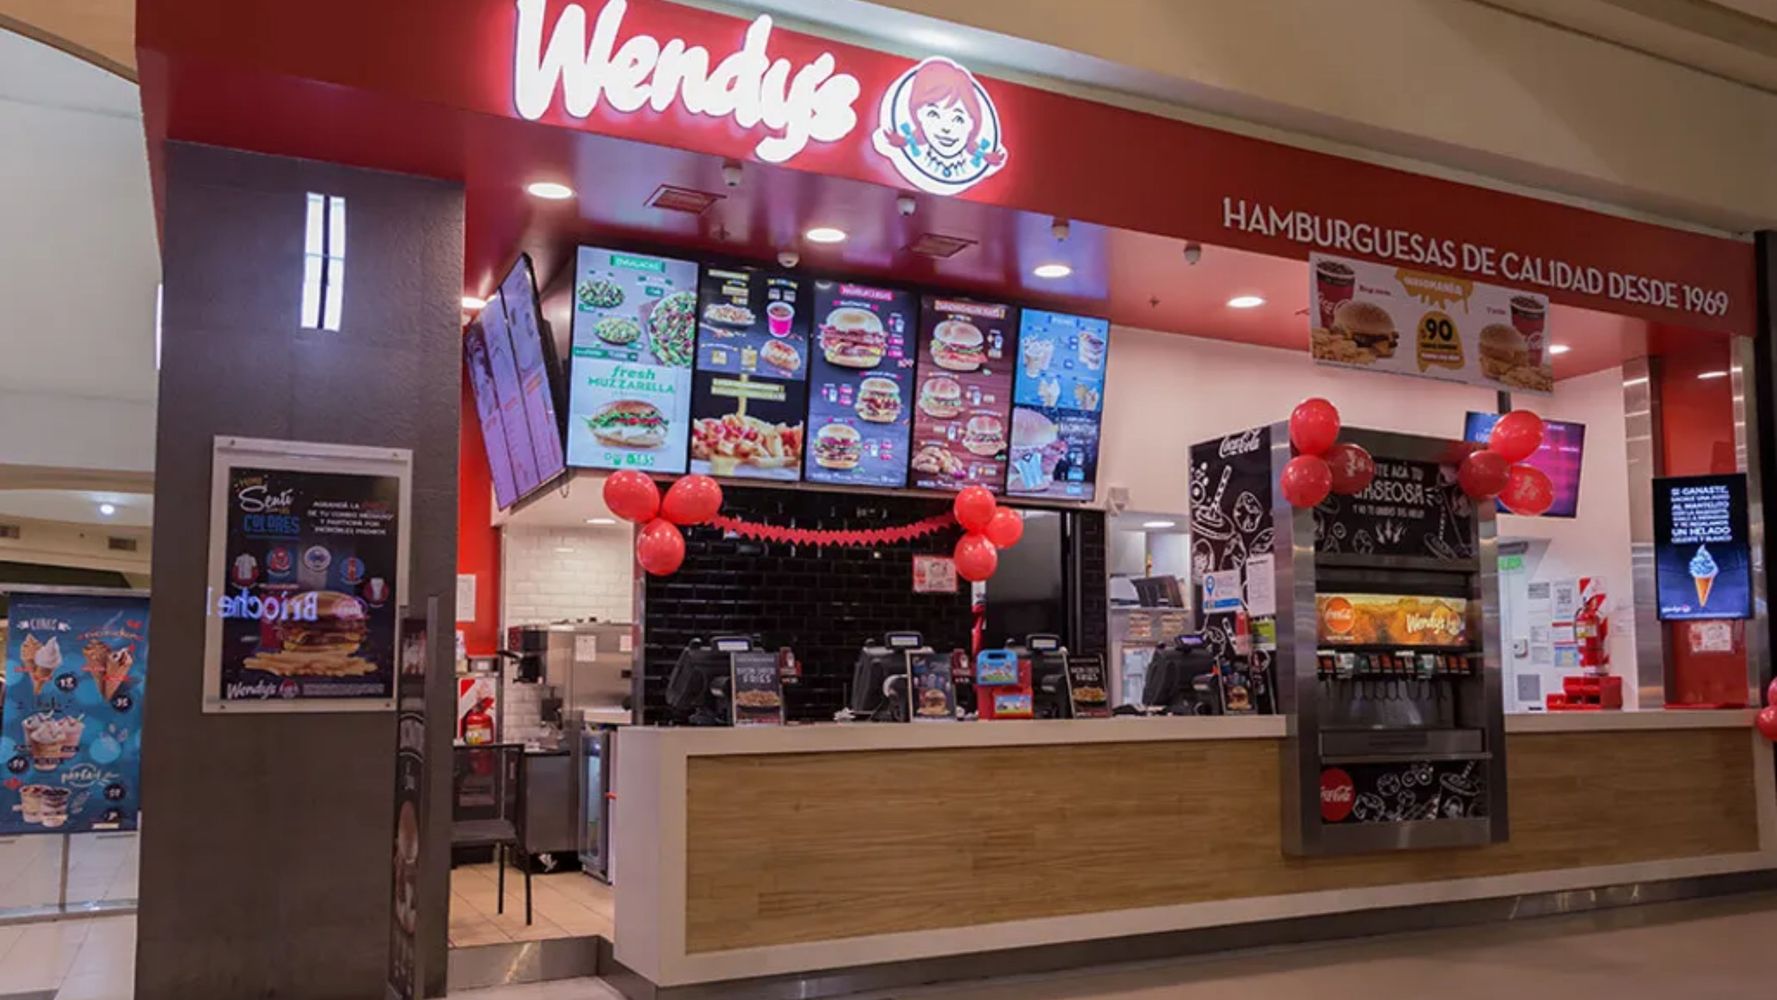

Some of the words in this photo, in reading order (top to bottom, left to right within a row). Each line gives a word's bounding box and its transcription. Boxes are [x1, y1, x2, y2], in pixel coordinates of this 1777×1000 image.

[513, 0, 860, 163] Wendy's
[1222, 197, 1457, 270] HAMBURGUESAS
[1462, 242, 1497, 276] DE
[1501, 252, 1602, 295] CALIDAD
[1608, 271, 1680, 309] DESDE
[1682, 284, 1730, 316] 1969
[611, 366, 656, 380] fresh
[588, 377, 676, 394] MUZZARELLA
[350, 502, 360, 510] LA
[243, 513, 300, 534] COLORES
[1690, 526, 1731, 536] HELADO
[1406, 611, 1446, 635] Wendy's
[226, 680, 277, 700] Wendy's
